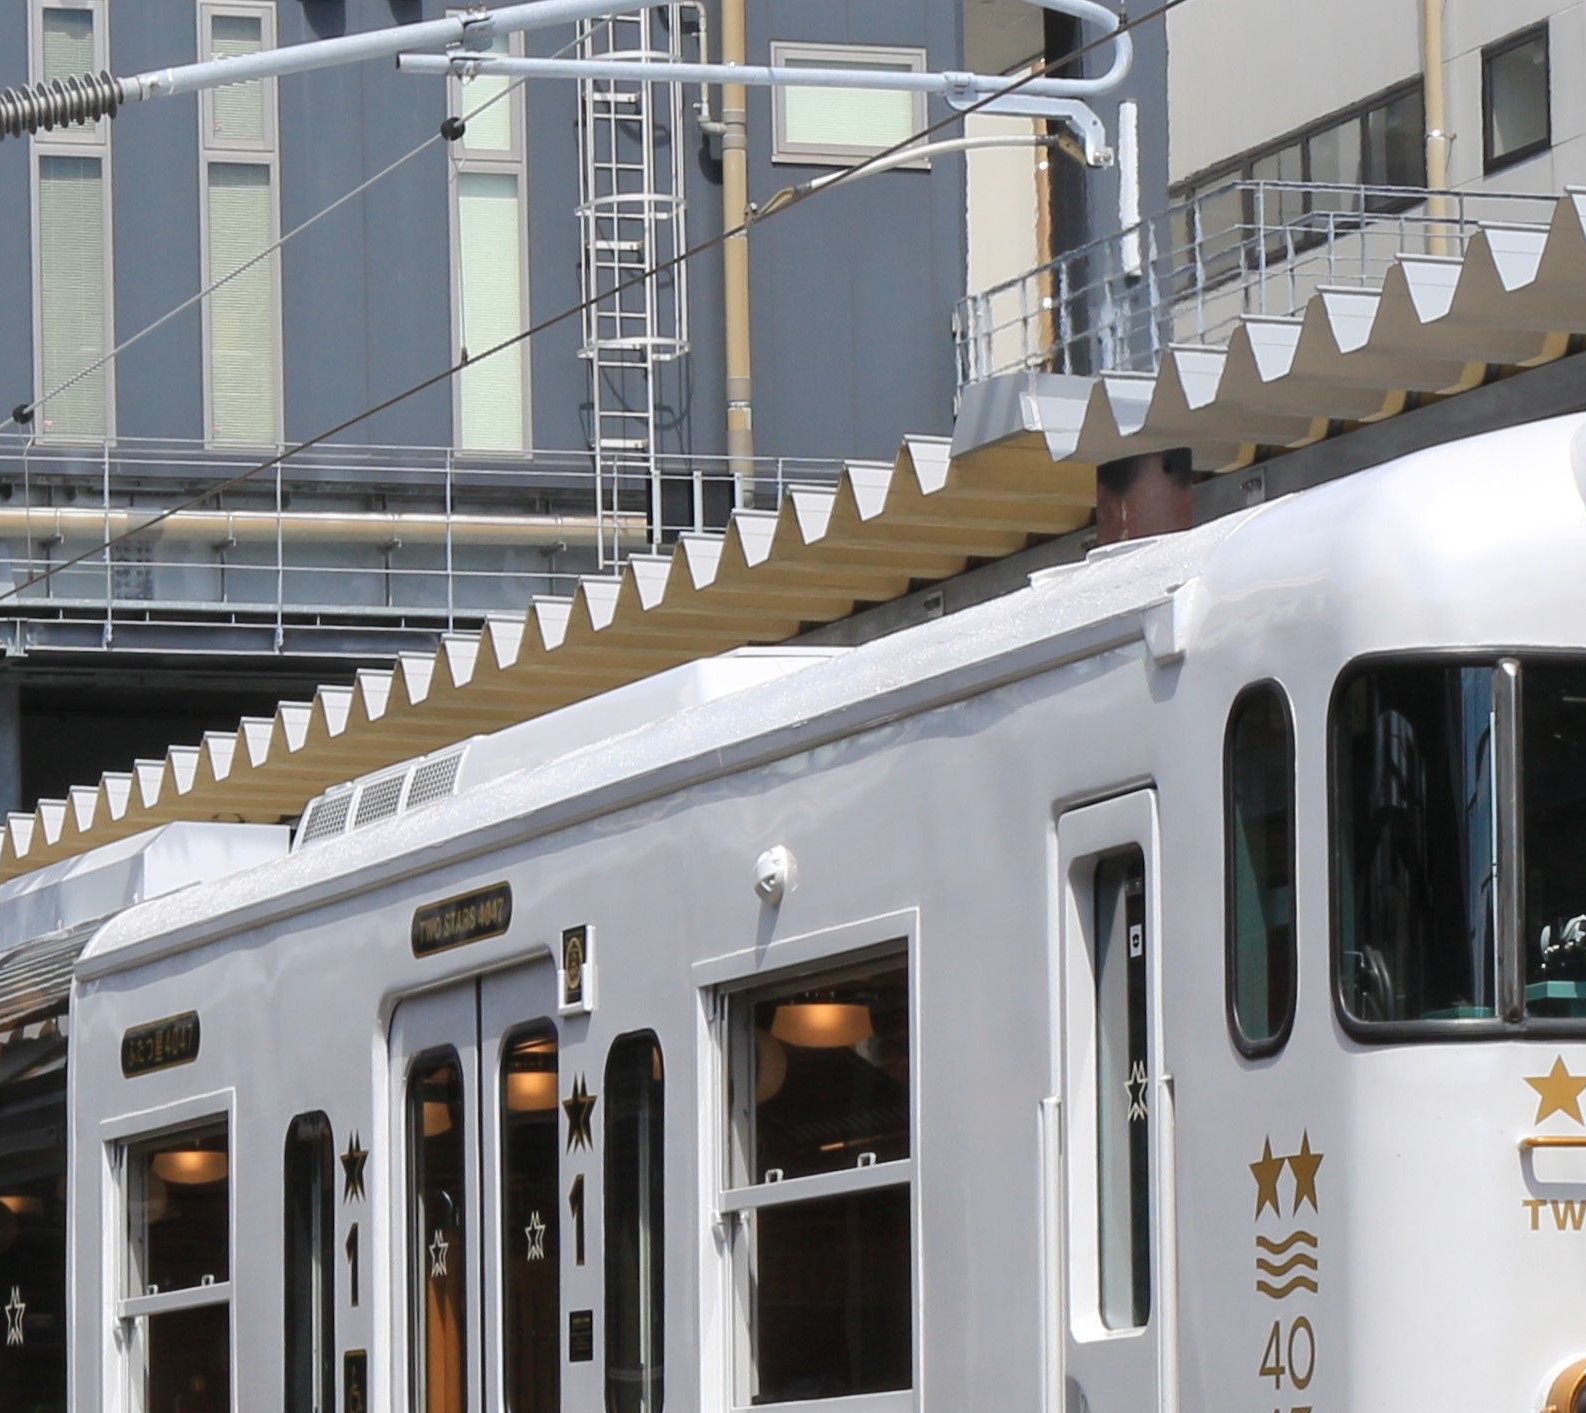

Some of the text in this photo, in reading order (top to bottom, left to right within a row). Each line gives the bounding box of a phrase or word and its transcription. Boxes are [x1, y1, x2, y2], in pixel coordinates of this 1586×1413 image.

[420, 896, 505, 943] TWO STARS 4047
[1258, 1315, 1316, 1391] 40
